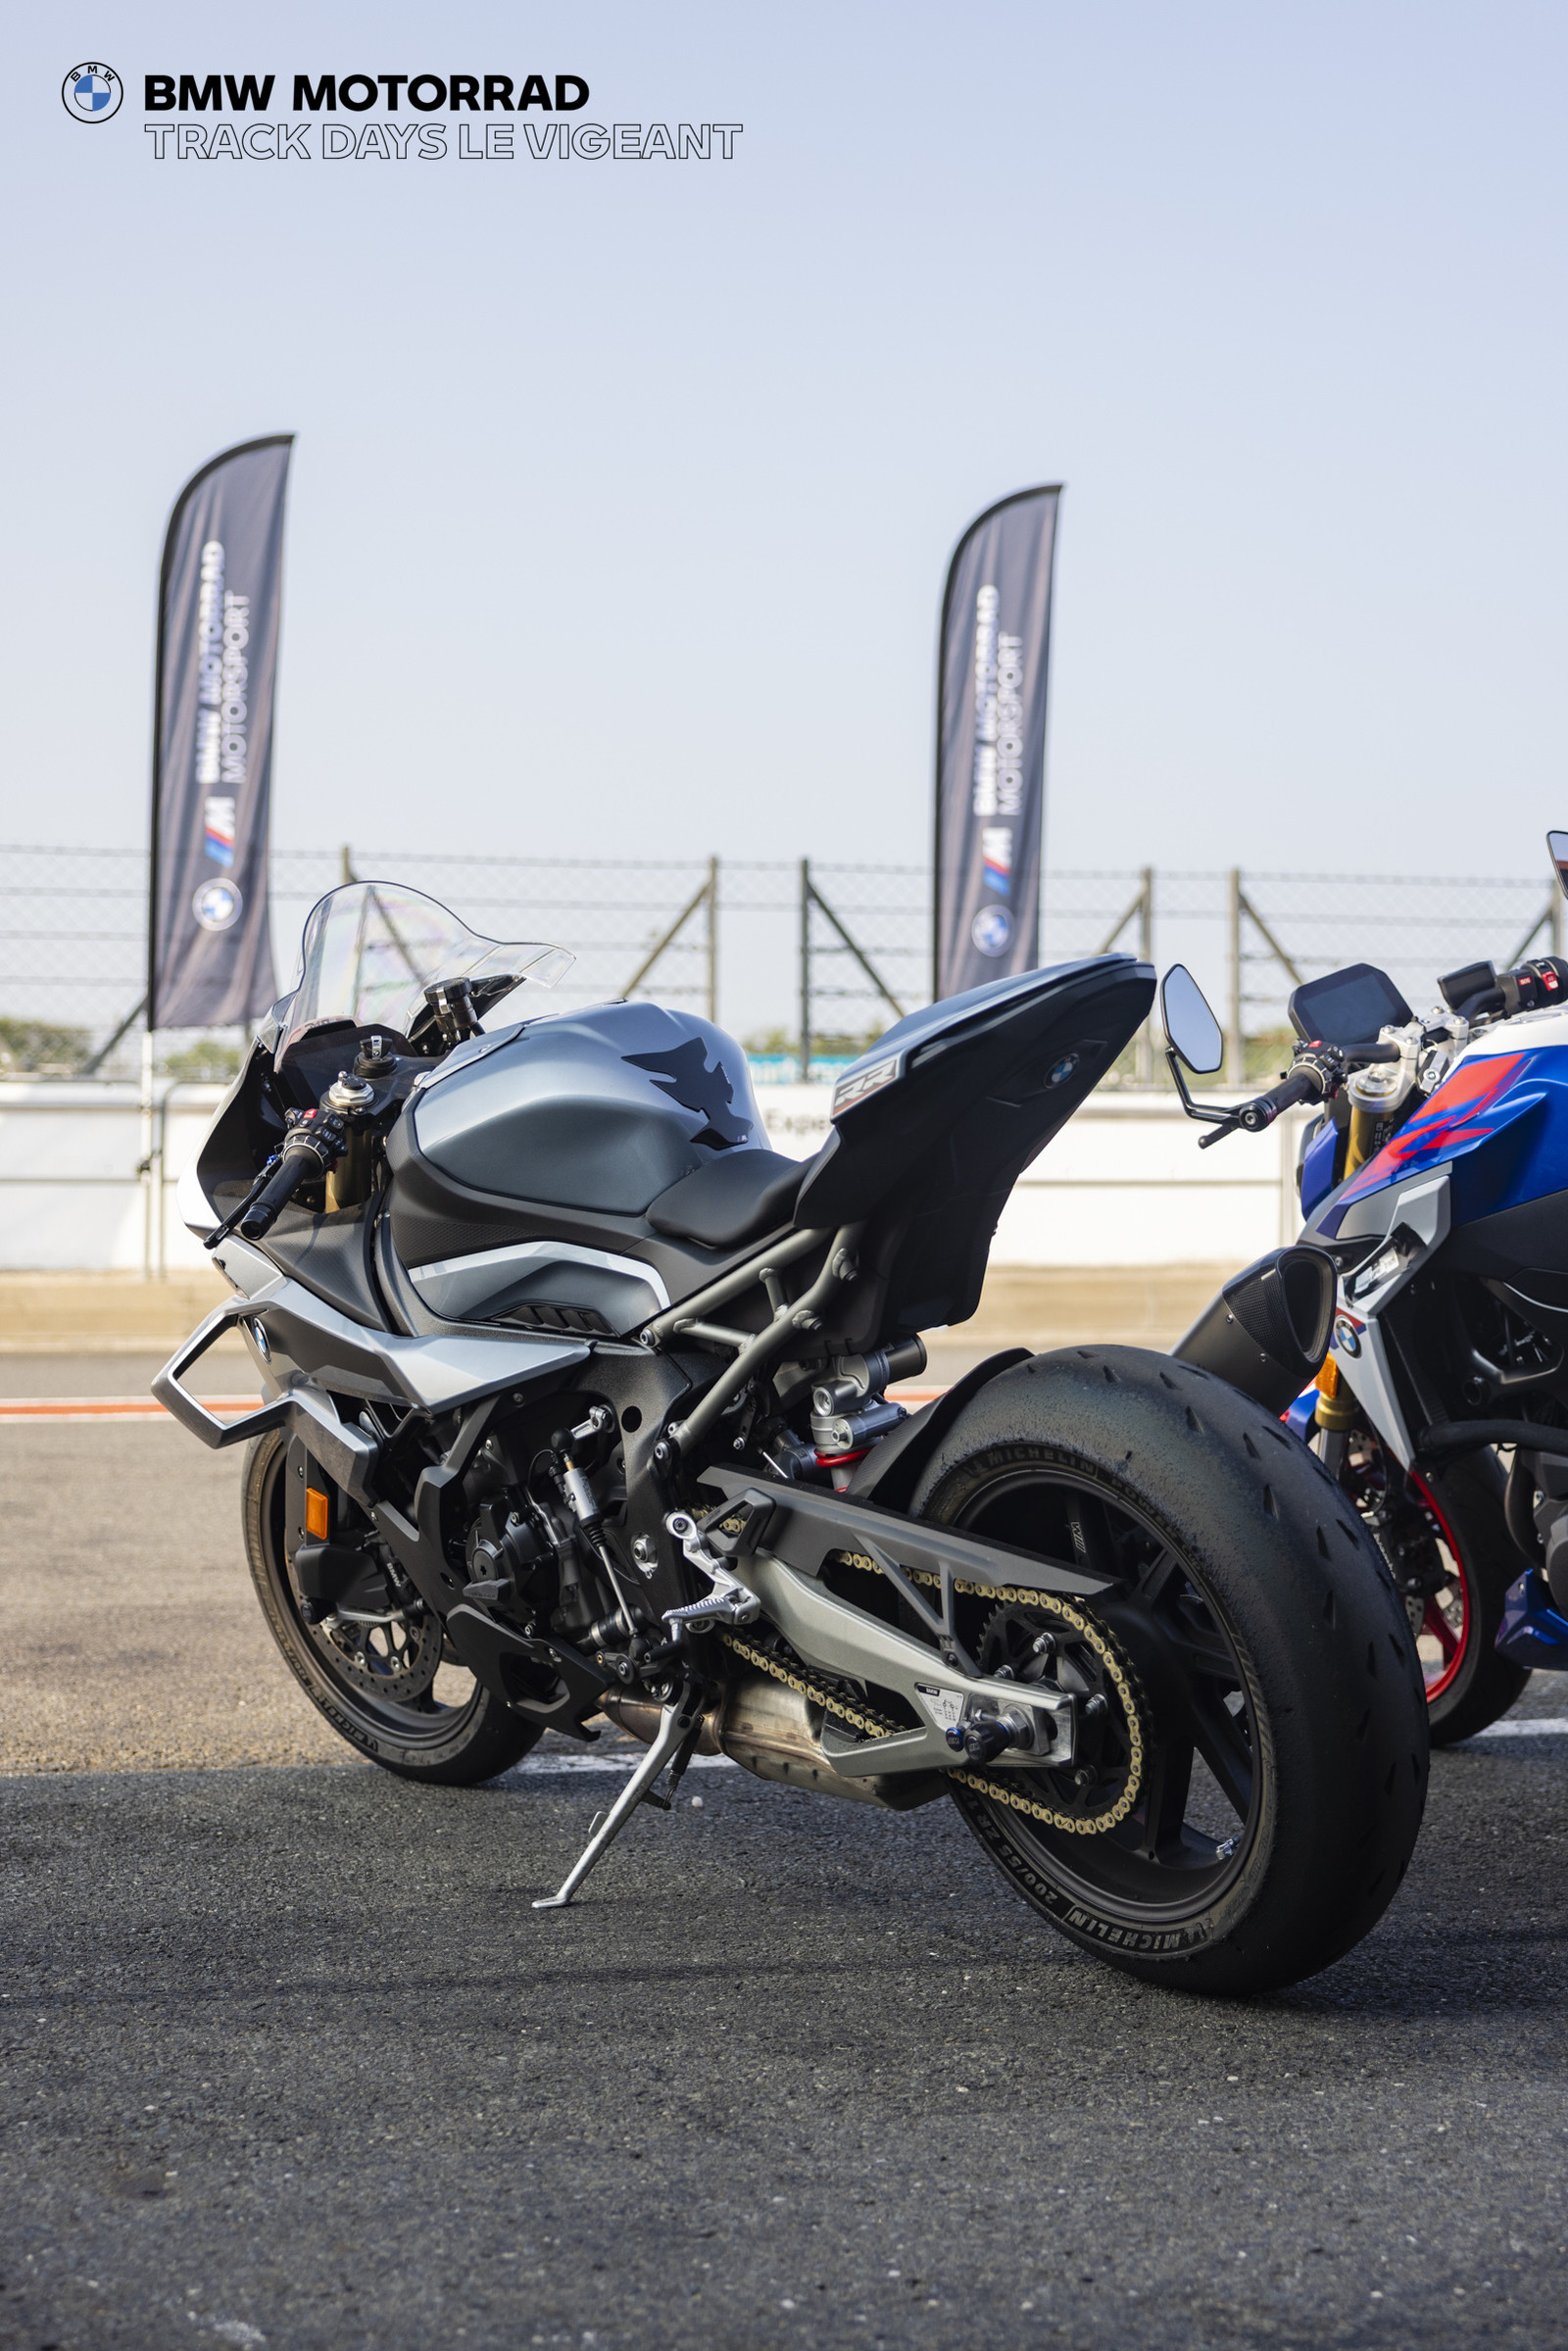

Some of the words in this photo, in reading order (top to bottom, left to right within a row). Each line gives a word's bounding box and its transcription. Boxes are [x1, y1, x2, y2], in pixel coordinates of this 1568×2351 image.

[197, 539, 225, 706] MOTORRAD
[220, 589, 251, 785] MOTORSPORT
[974, 583, 1000, 743] MOTORRAD
[195, 708, 221, 785] BMW
[997, 630, 1023, 816] MOTORSPORT
[834, 1058, 897, 1106] RR
[988, 1448, 1096, 1476] MICHELIN
[386, 1562, 401, 1588] BMW
[976, 1812, 1002, 1840] ZR
[998, 1842, 1058, 1905] 200/55
[1068, 1909, 1182, 1951] MICHELIN
